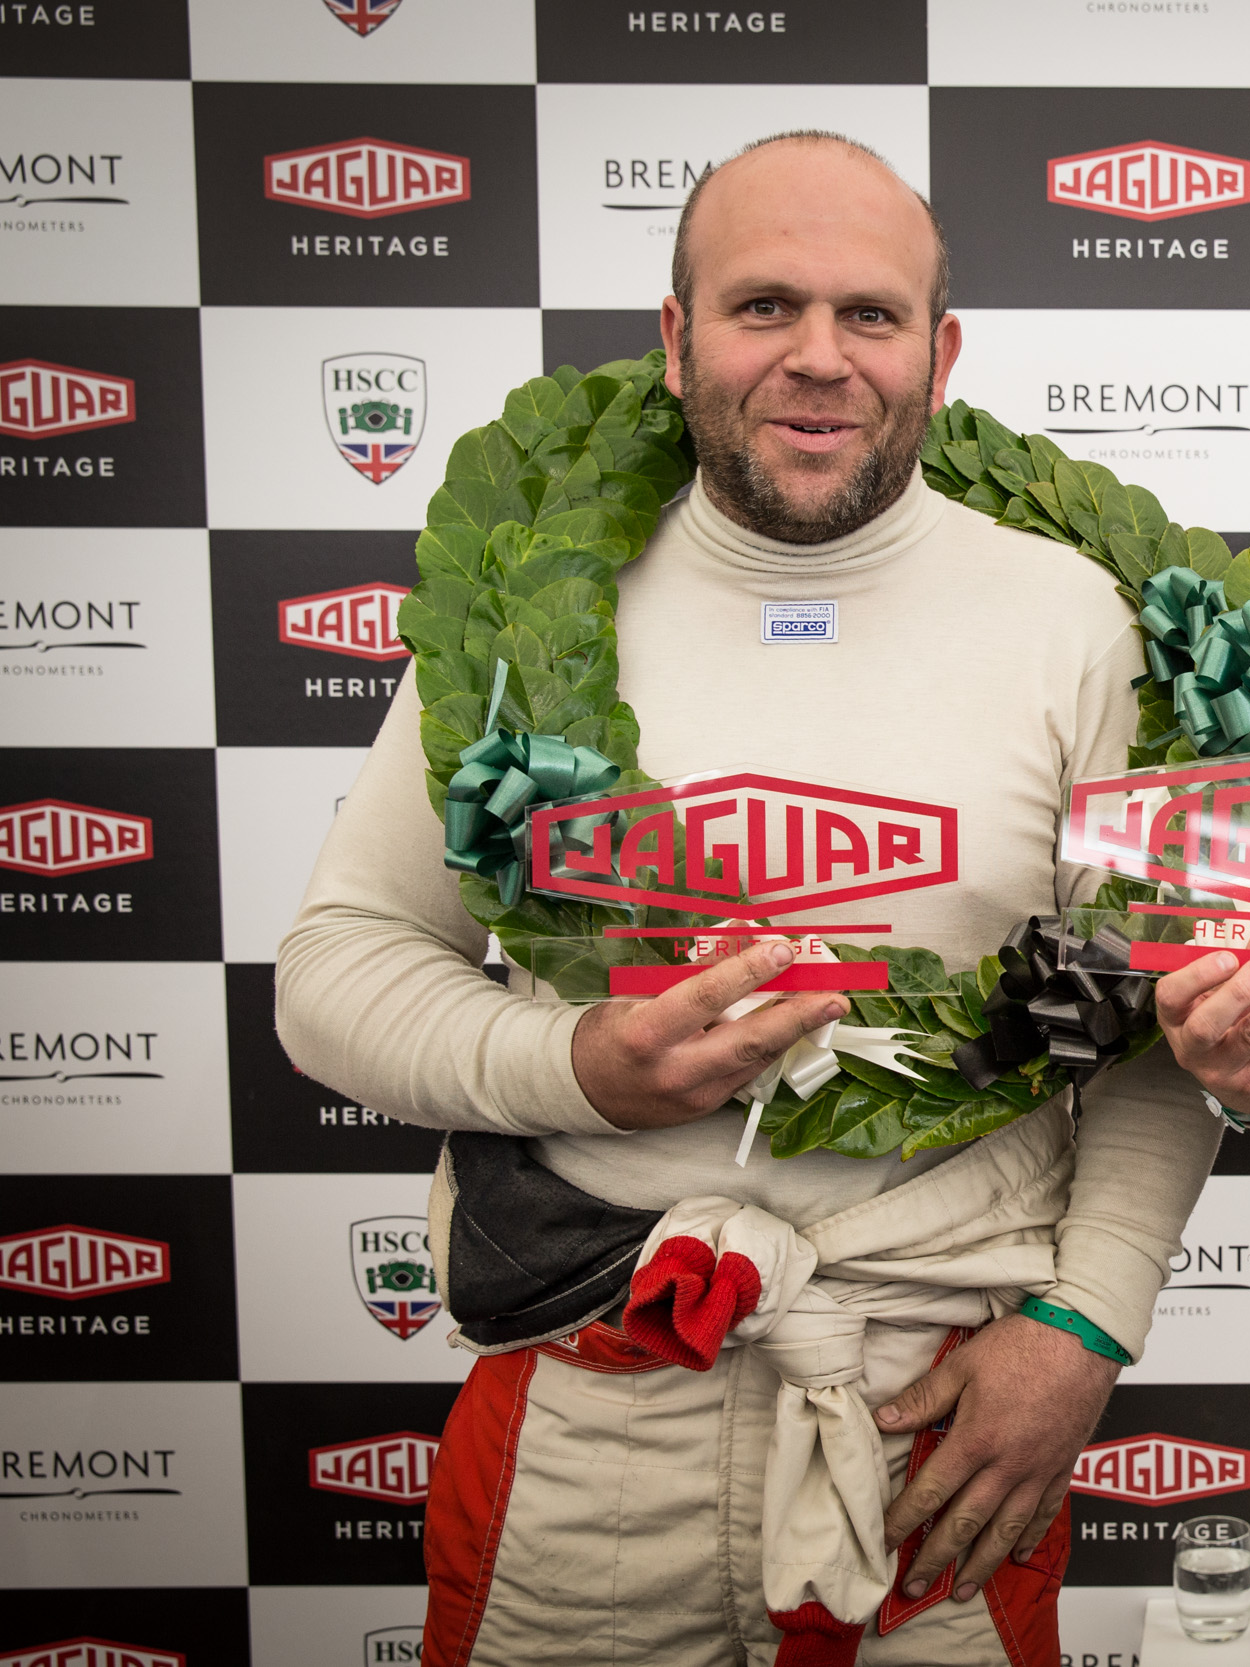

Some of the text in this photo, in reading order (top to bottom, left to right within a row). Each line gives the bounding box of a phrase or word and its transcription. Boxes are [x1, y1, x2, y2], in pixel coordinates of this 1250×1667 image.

[0, 4, 95, 25] ITAGE
[1086, 2, 1209, 13] CHRONOMETERS
[628, 12, 786, 33] HERITAGE
[0, 153, 123, 185] MONT
[275, 148, 459, 209] JAGUAR
[605, 159, 713, 188] BREM
[1059, 151, 1240, 211] JAGUAR
[0, 221, 85, 232] NOMETERS
[291, 235, 449, 256] HERITAGE
[1072, 238, 1229, 259] HERITAGE
[332, 368, 418, 392] HSCC
[0, 370, 123, 429] GUAR
[1047, 384, 1249, 413] BREMONT
[1088, 449, 1209, 460] CHRONOMETERS
[0, 456, 115, 477] RITAGE
[772, 621, 825, 635] sparco
[2, 665, 104, 676] RONOMETERS
[305, 677, 397, 698] HERIT
[0, 808, 140, 866] AGUAR
[565, 797, 925, 897] JAGUAR
[0, 893, 133, 913] ERITAGE
[0, 1032, 158, 1062] EMONT
[0, 1235, 159, 1289] AGUAR
[0, 1315, 151, 1335] HERITAGE
[2, 1450, 176, 1479] REMONT
[320, 1441, 434, 1495] JAGU
[1072, 1443, 1241, 1497] JAGUAR
[19, 1510, 140, 1522] CHRONOMETERS
[335, 1520, 424, 1540] HERIT
[1081, 1521, 1230, 1541] HERITAGE
